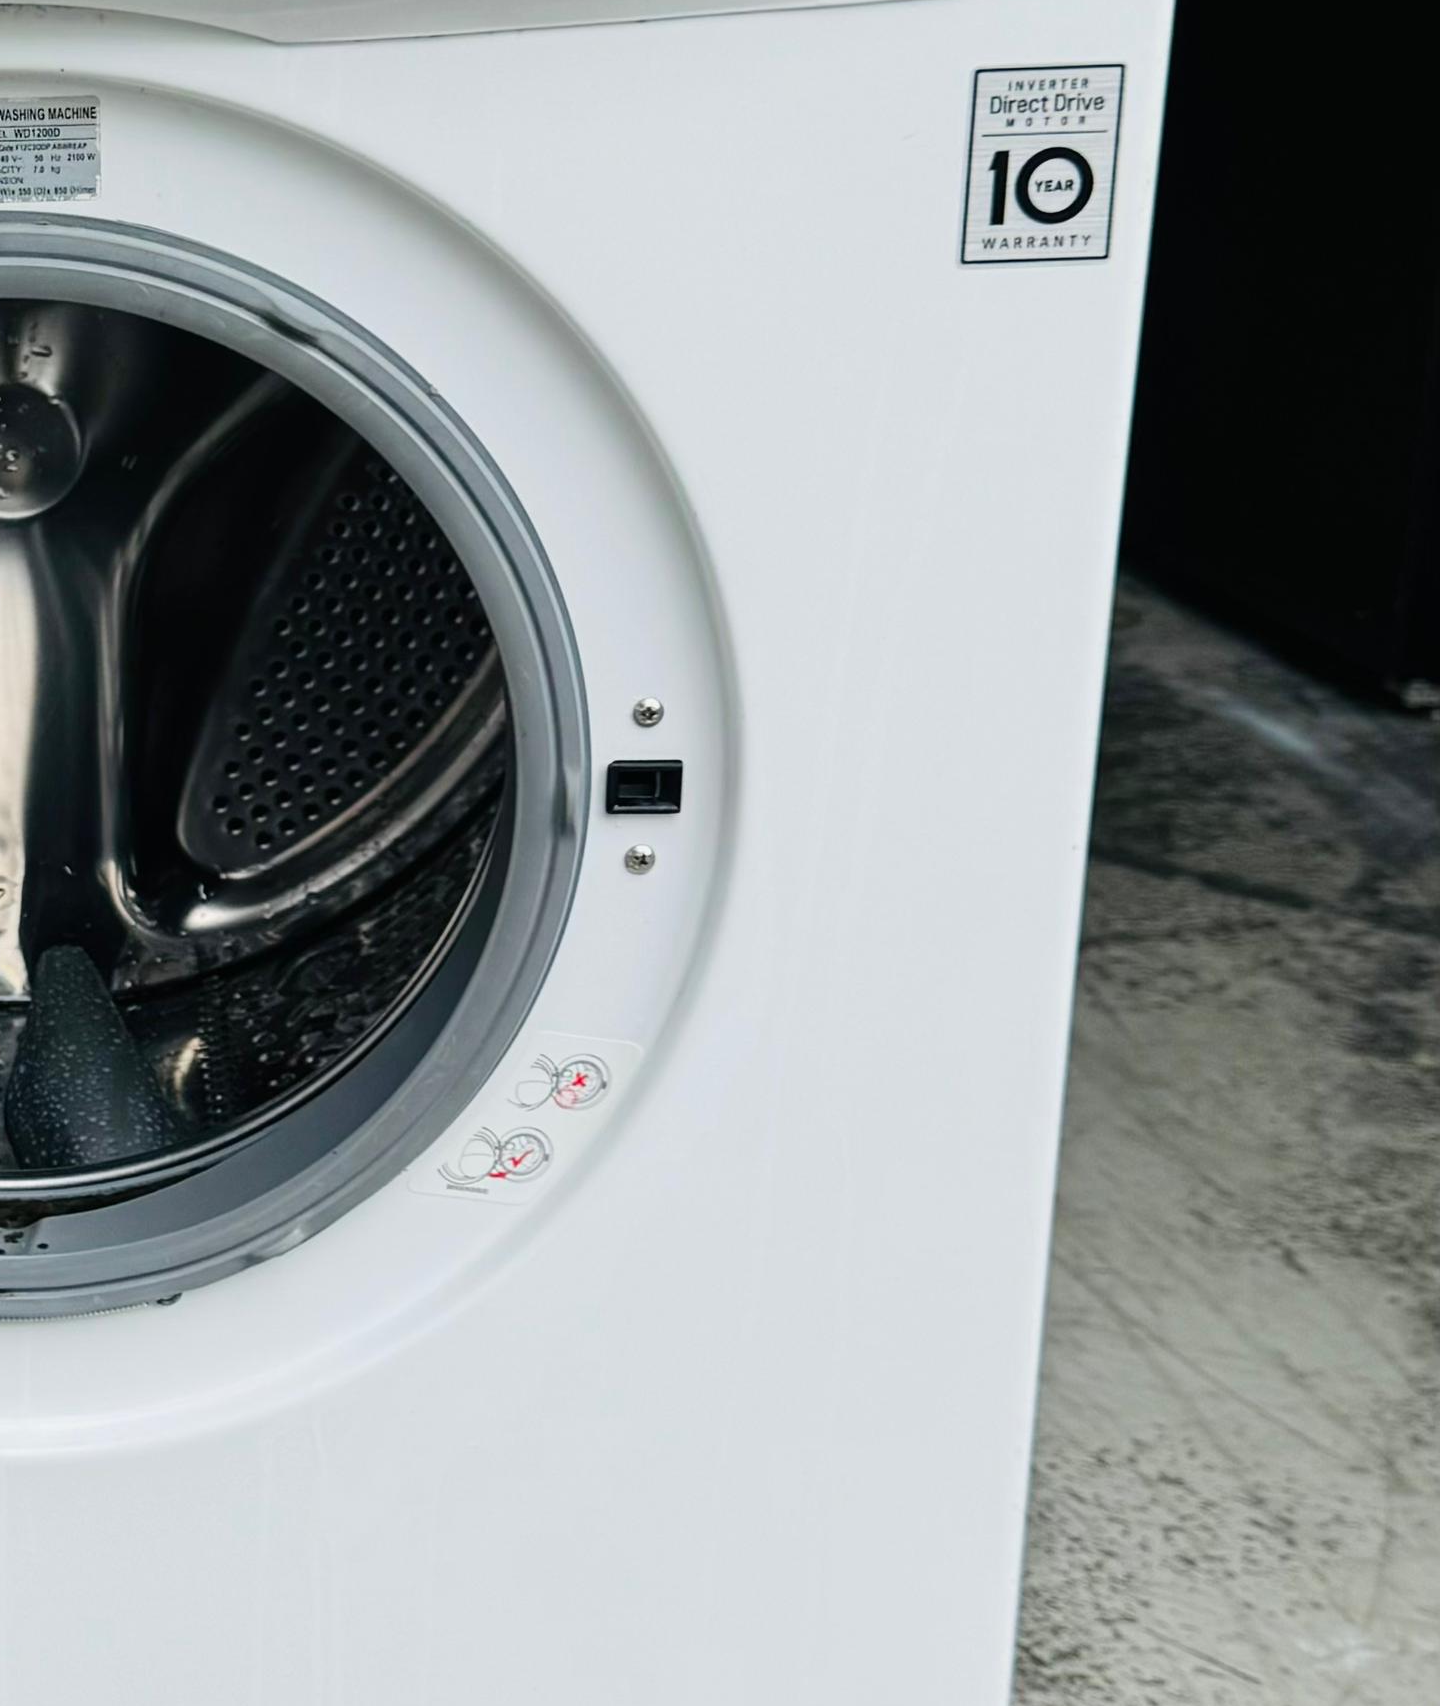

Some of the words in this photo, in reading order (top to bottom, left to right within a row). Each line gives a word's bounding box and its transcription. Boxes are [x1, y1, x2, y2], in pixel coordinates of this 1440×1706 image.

[1009, 79, 1089, 91] INVERTER
[990, 96, 1048, 114] Direct
[1055, 94, 1104, 111] Drive
[48, 107, 96, 119] MACHINE
[1007, 117, 1086, 127] MOTOR
[989, 147, 1093, 225] 10
[1035, 180, 1074, 192] YEAR
[983, 235, 1091, 249] WARRANTY
